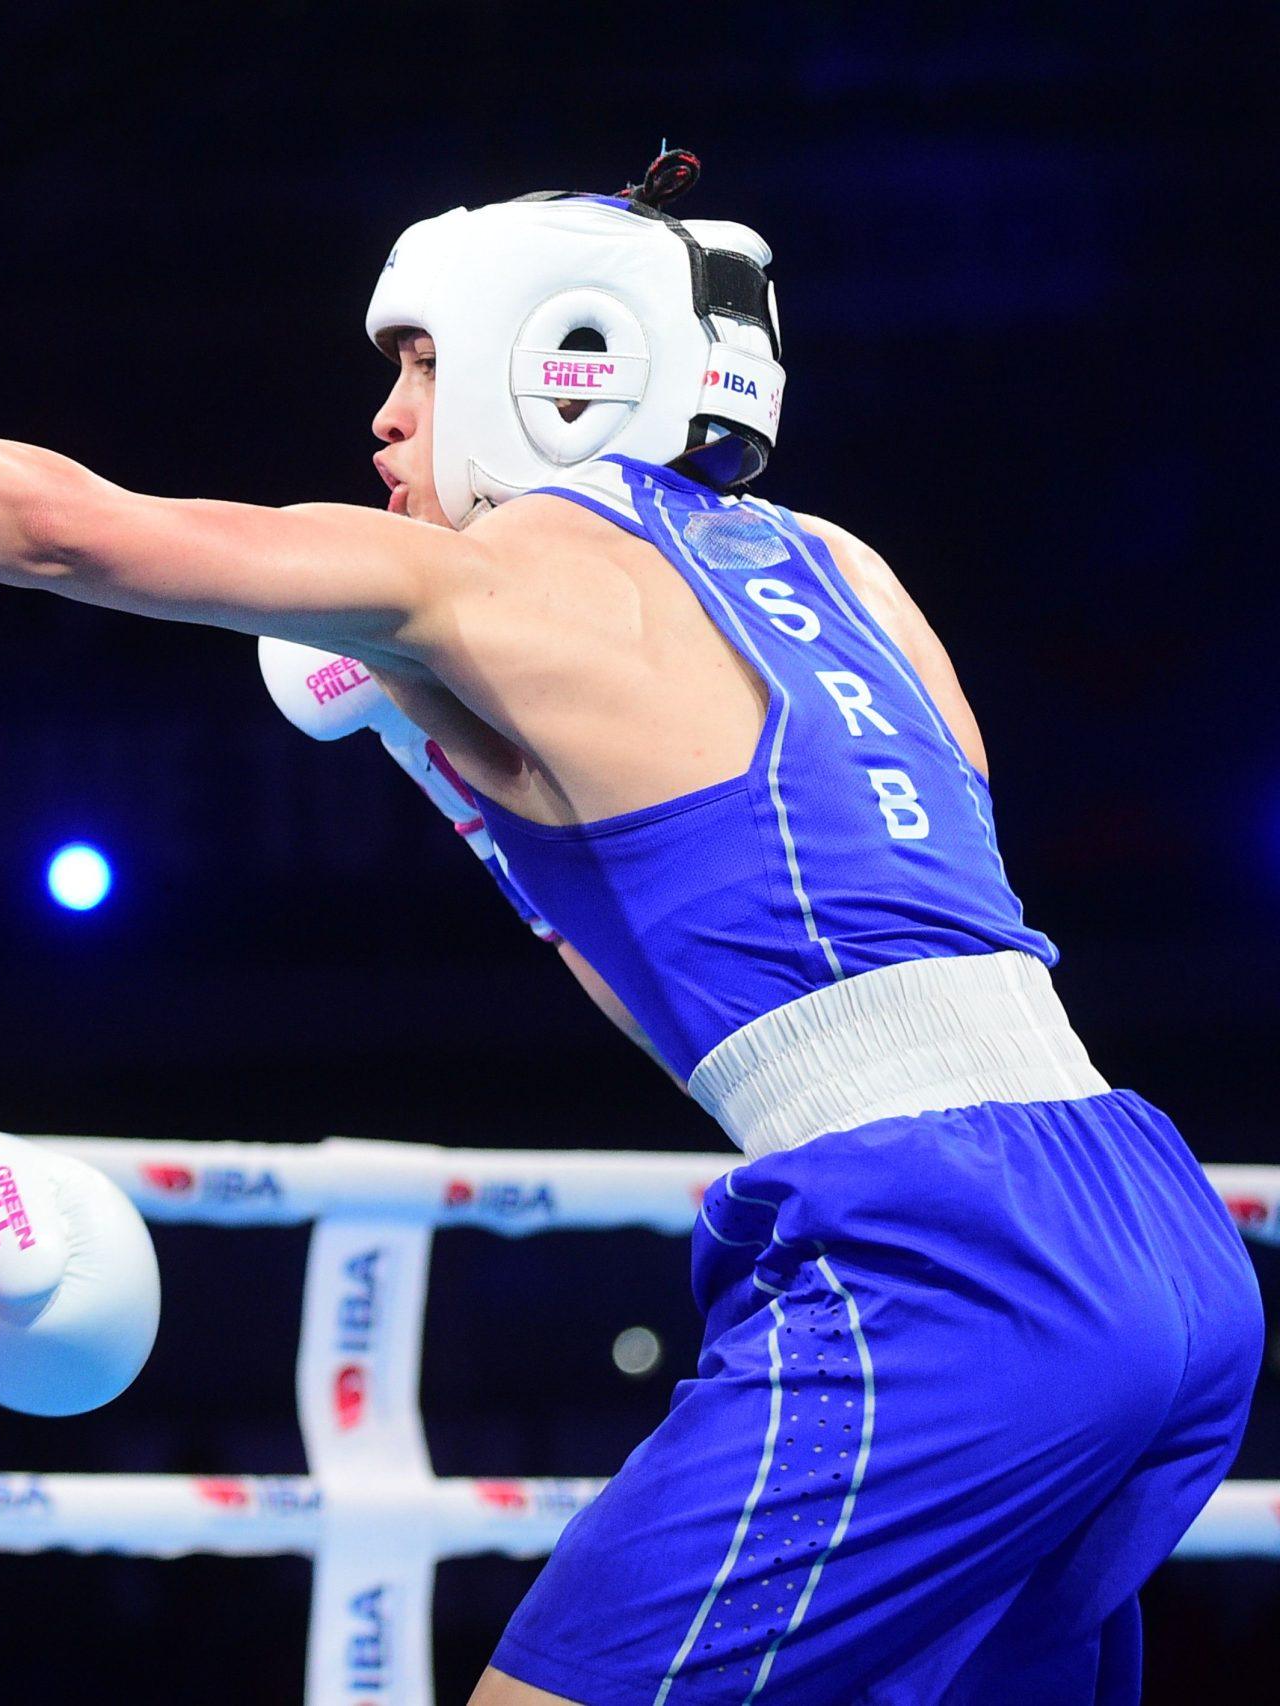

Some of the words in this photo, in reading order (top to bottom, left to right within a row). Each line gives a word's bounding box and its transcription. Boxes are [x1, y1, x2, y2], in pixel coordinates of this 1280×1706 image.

[542, 361, 615, 375] GREEN
[544, 372, 602, 388] HILL
[723, 371, 758, 400] IBA
[306, 655, 362, 690] GREE
[314, 668, 371, 704] HILL
[337, 1248, 381, 1353] IBA
[350, 1584, 384, 1690] IBA
